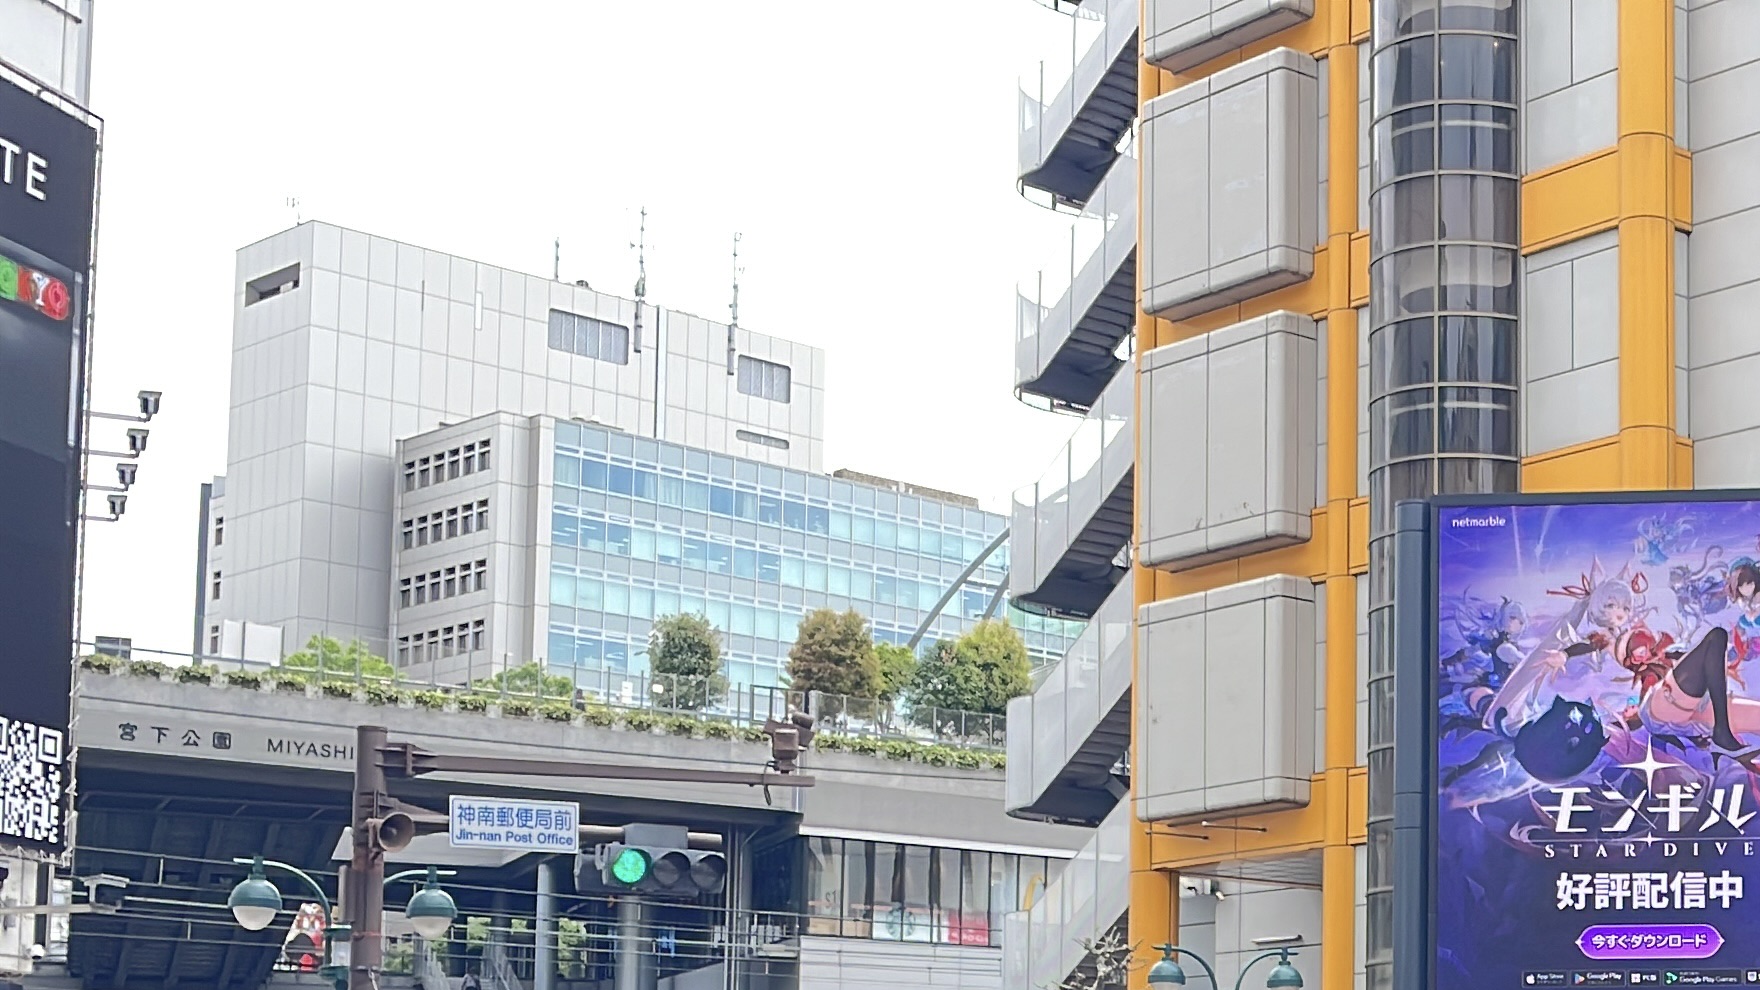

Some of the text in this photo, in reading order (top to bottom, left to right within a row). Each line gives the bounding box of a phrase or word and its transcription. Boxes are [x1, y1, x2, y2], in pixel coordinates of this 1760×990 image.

[1452, 516, 1506, 528] netmarble
[118, 721, 232, 750] 宮下公園
[267, 738, 355, 760] MIYASHI
[1541, 782, 1757, 835] モンギル
[457, 804, 573, 831] 神南郵便局前
[456, 829, 573, 845] Jin-nan Post Office
[1544, 841, 1755, 858] STAR DIVE
[1556, 870, 1744, 910] 好評配信中
[1591, 933, 1707, 949] 今すぐダウンロード
[1586, 972, 1622, 981] Google Play
[1680, 976, 1702, 984] Google
[1702, 976, 1715, 984] Play
